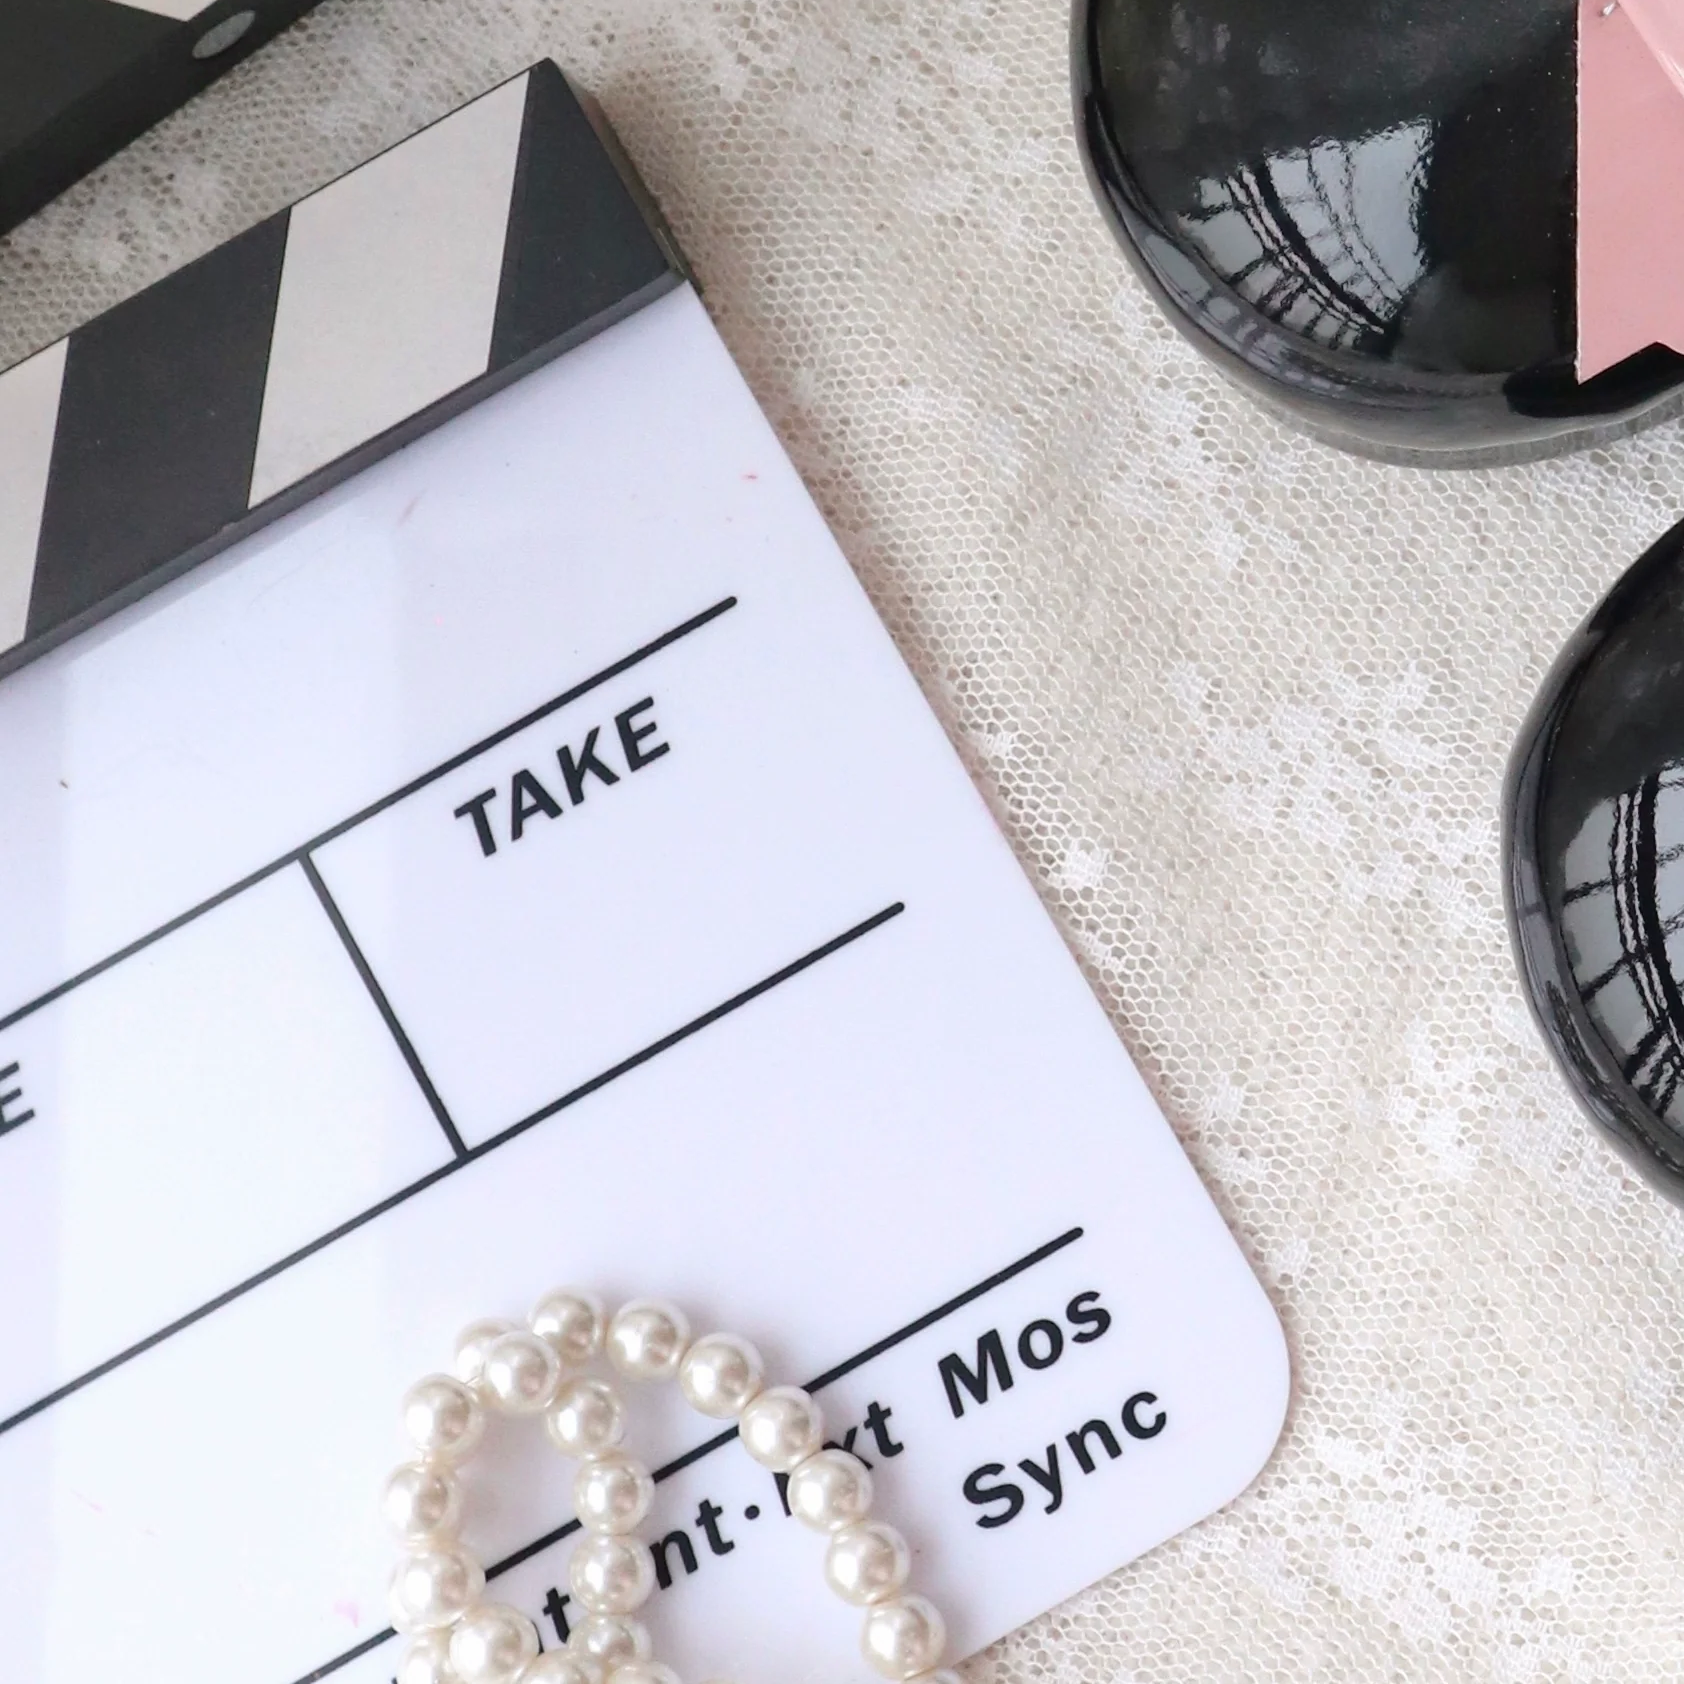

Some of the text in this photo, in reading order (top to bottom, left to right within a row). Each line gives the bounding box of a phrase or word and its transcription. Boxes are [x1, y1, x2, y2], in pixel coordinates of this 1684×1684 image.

[453, 695, 671, 858] TAKE
[936, 1288, 1114, 1420] Mos
[961, 1389, 1169, 1530] Sync
